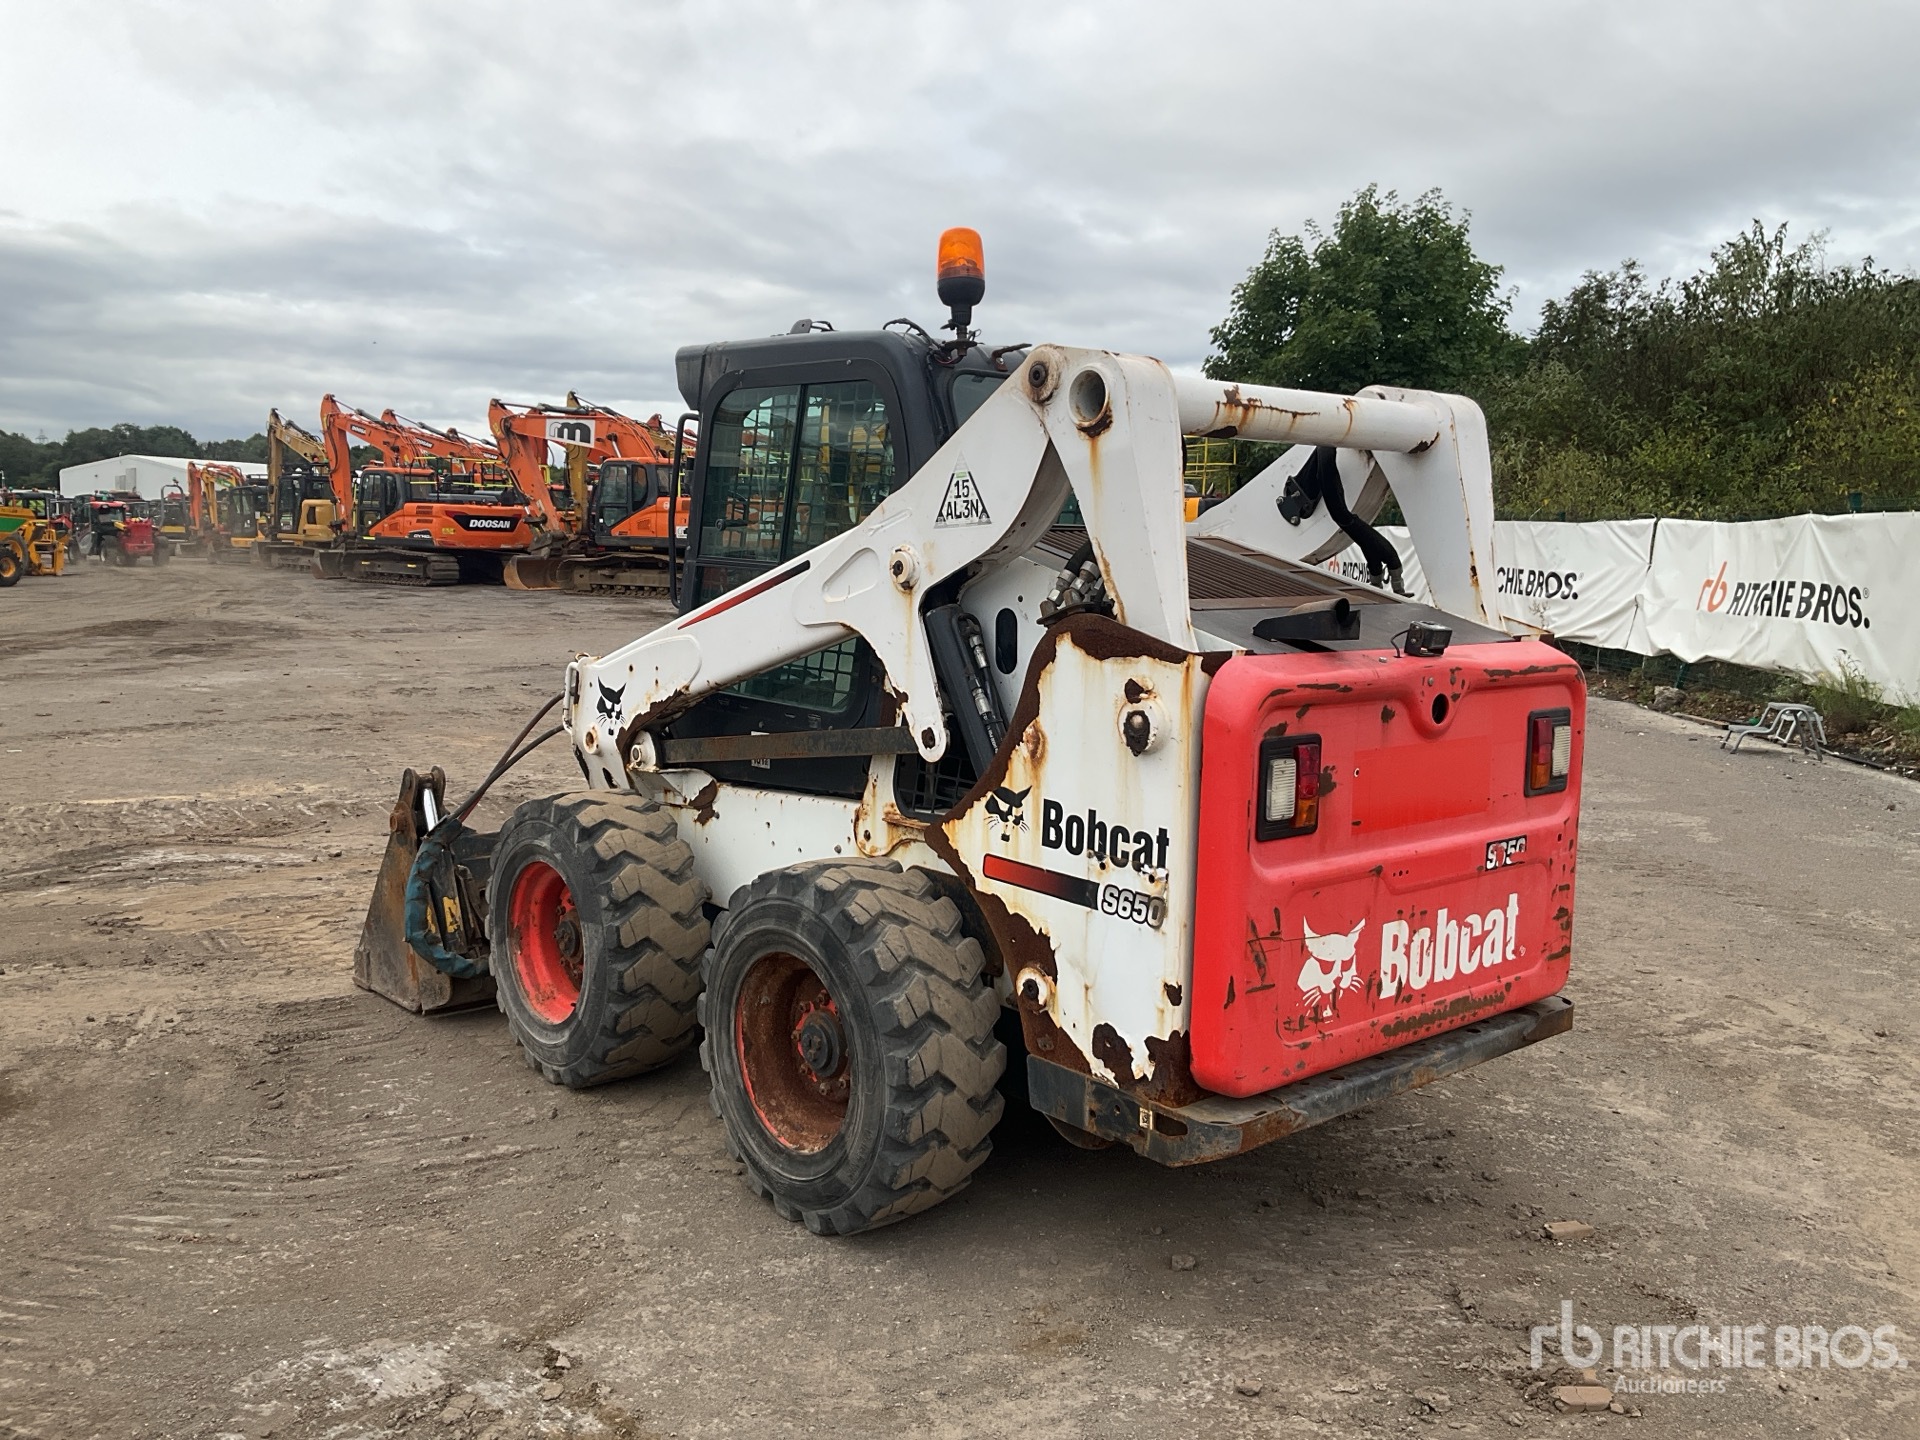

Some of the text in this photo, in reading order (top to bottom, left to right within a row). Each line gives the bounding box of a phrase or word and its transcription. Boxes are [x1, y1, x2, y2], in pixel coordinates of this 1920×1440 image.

[954, 479, 970, 498] 15
[469, 519, 511, 529] DOOSAN
[946, 499, 979, 519] AL3N
[1497, 566, 1579, 600] CHIE BROS.
[1726, 580, 1796, 617] RITCHIE
[1795, 581, 1870, 629] BROS.
[1042, 798, 1169, 873] Bobcat
[1101, 884, 1167, 929] S650
[1379, 892, 1519, 999] Bobcat
